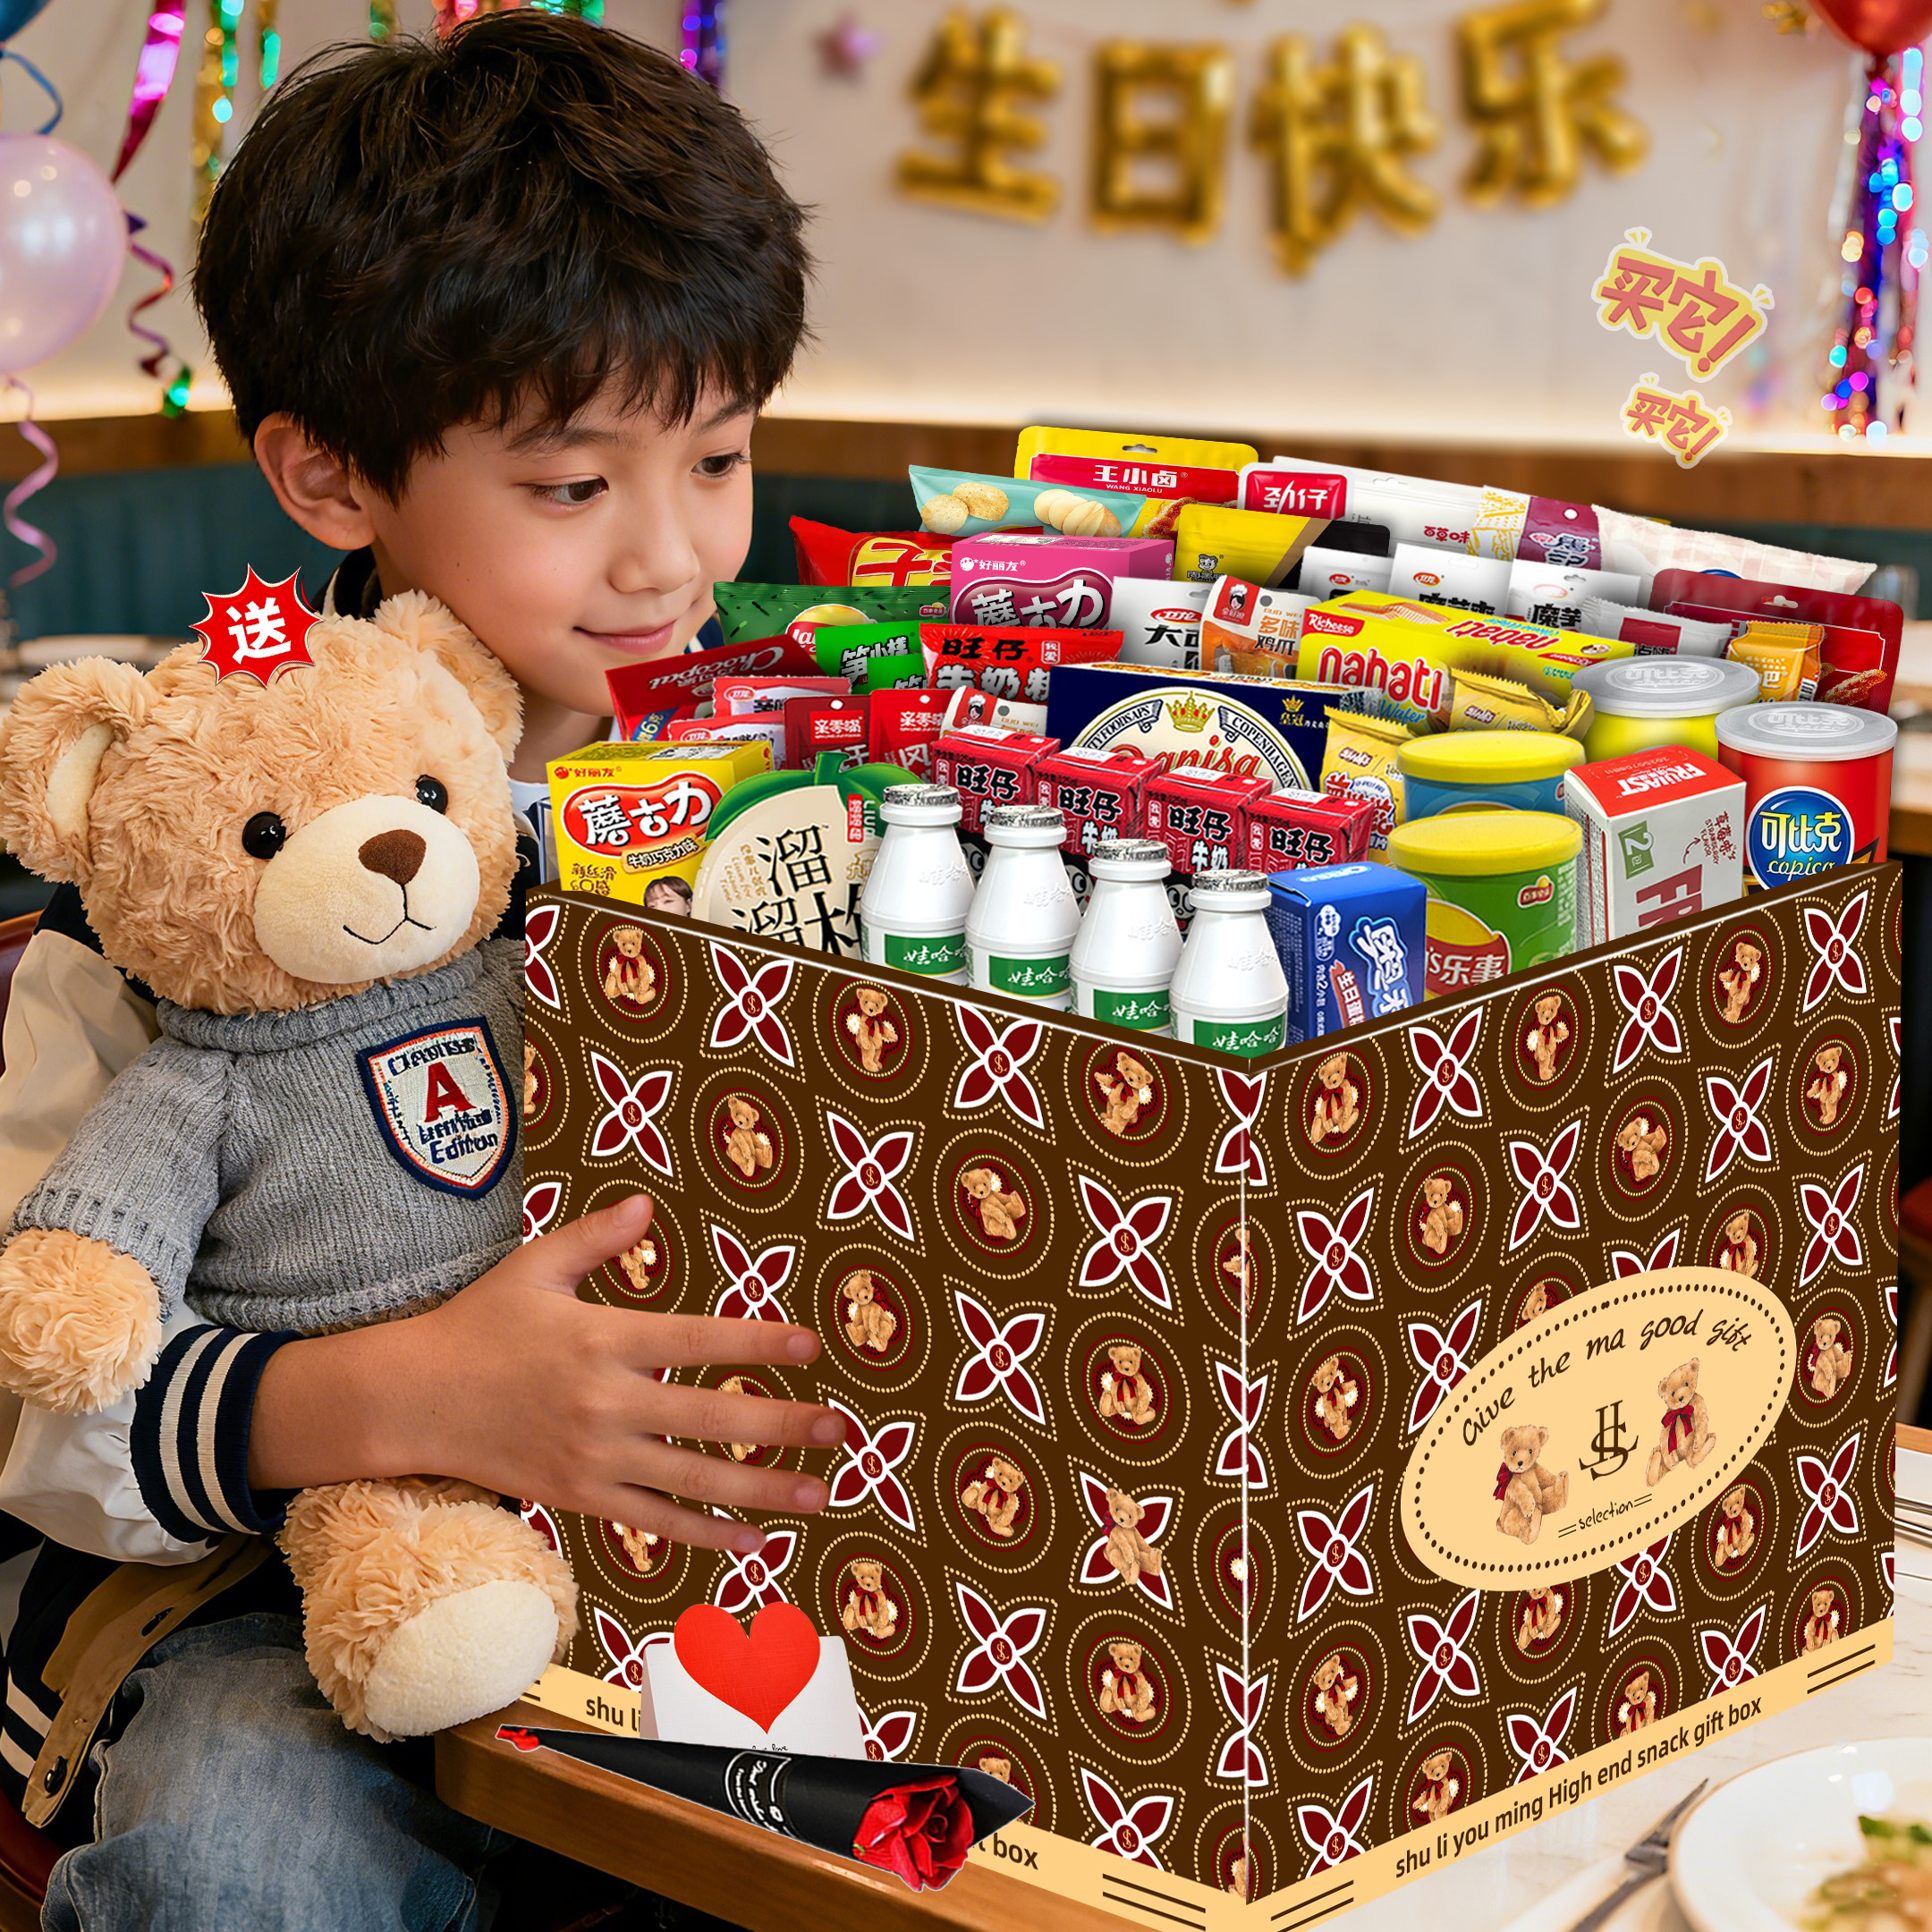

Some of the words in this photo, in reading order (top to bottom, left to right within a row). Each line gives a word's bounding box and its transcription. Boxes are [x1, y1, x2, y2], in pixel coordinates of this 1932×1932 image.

[894, 0, 1653, 279] 生日快乐
[1093, 464, 1178, 488] 王小卤
[1106, 483, 1131, 491] WANG
[1133, 486, 1163, 494] XIAOLU
[1263, 480, 1328, 514] 劲仔
[1424, 526, 1471, 544] 百草味
[979, 560, 1019, 572] 好丽友
[1258, 616, 1301, 639] 多味
[1308, 614, 1355, 634] Richeese
[941, 638, 1029, 661] 旺仔
[1254, 635, 1296, 657] 鸡爪
[648, 647, 785, 689] Chocopai
[1318, 646, 1443, 710] nabati
[1380, 699, 1426, 724] Wafer
[574, 767, 614, 778] 好丽友
[956, 764, 1021, 801] 旺仔
[577, 782, 713, 846] 蘑古力
[1058, 785, 1123, 822] 旺仔
[1168, 805, 1234, 842] 旺仔
[1758, 811, 1842, 859] 可比克
[626, 837, 699, 869] 牛奶巧克力味
[756, 825, 832, 896] 溜
[1270, 826, 1335, 863] 旺仔
[1439, 954, 1506, 986] 乐事
[1212, 1026, 1282, 1051] 娃哈哈
[424, 1062, 478, 1123] A
[1529, 1352, 1572, 1388] the
[1586, 1328, 1626, 1360] ma
[1640, 1309, 1705, 1351] good
[1579, 1500, 1634, 1530] selection
[586, 1695, 623, 1727] shu
[1396, 1846, 1431, 1878] shu
[1436, 1832, 1448, 1860] li
[1453, 1820, 1489, 1858] you
[1495, 1795, 1544, 1834] ming
[1549, 1770, 1592, 1809] High
[1597, 1750, 1632, 1786] end
[1637, 1725, 1690, 1768] snack
[1693, 1710, 1724, 1748] gift
[1728, 1696, 1762, 1727] box
[993, 1833, 1038, 1870] box
